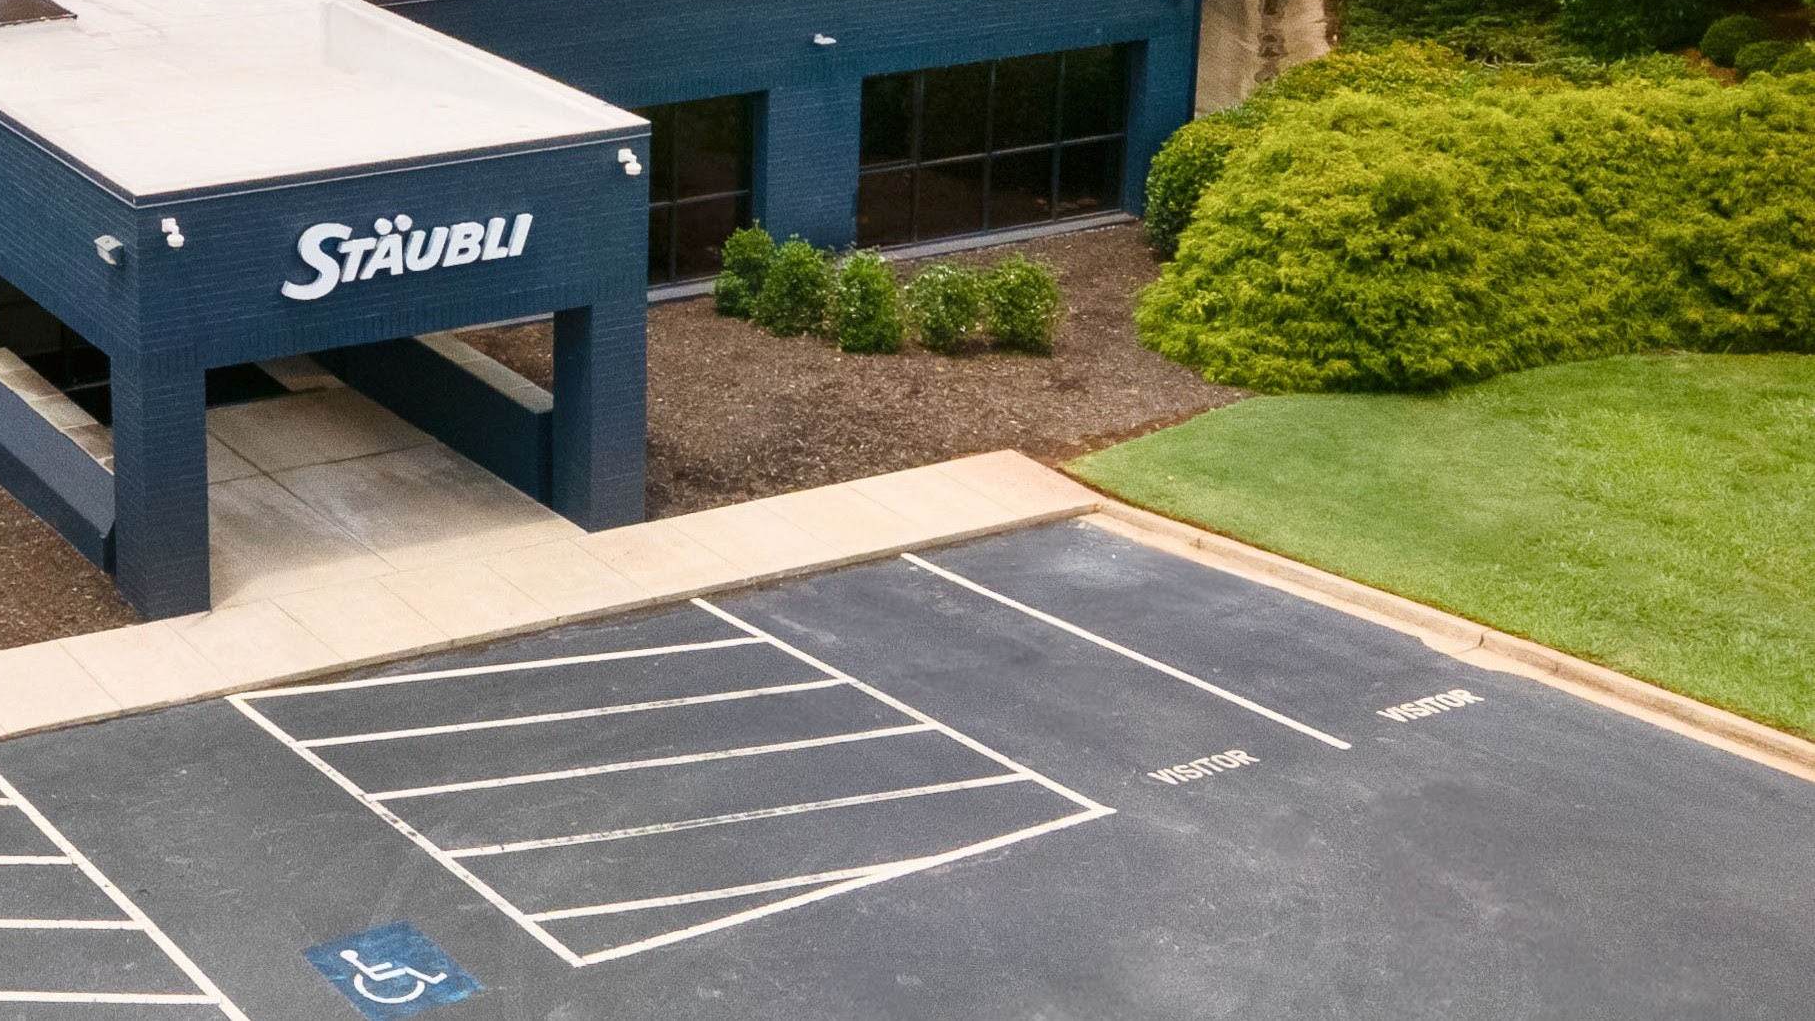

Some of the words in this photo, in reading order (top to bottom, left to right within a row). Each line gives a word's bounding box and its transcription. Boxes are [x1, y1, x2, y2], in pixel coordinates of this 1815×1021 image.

[281, 213, 533, 301] STÄUBLI
[1376, 688, 1485, 723] VISITOR
[1147, 749, 1261, 786] VISITOR
